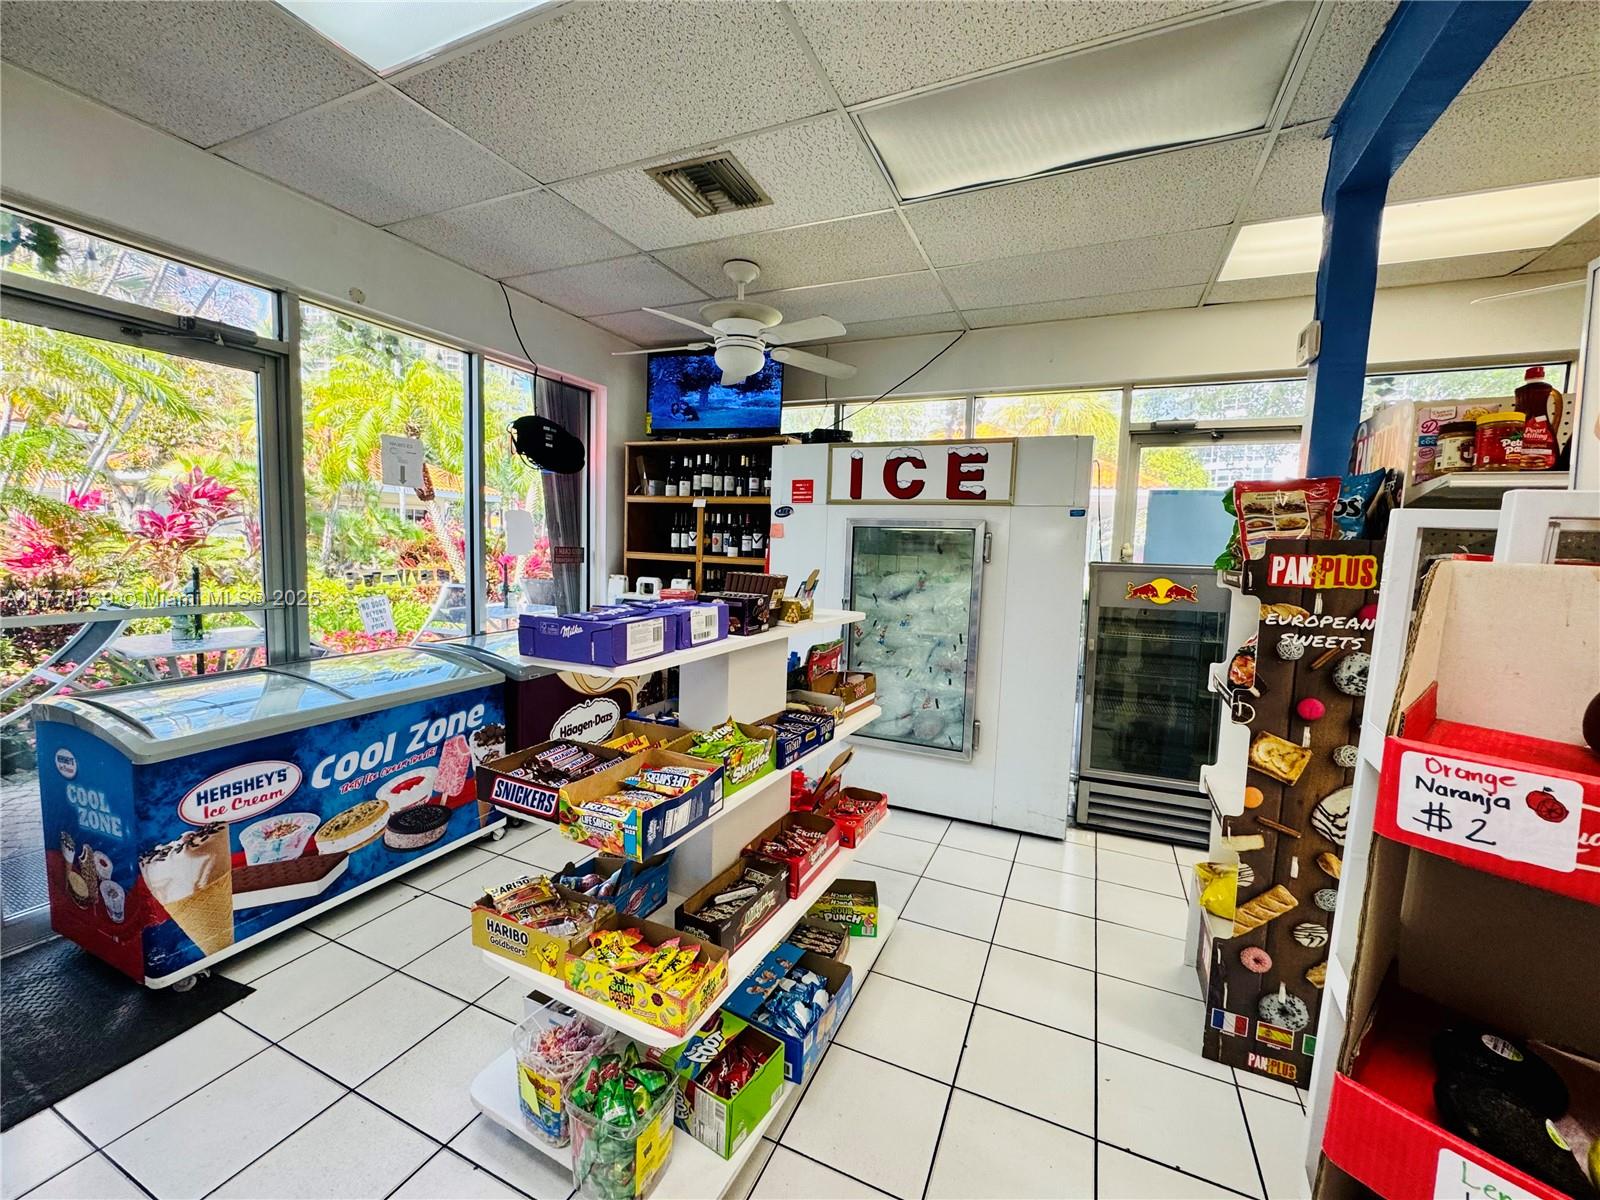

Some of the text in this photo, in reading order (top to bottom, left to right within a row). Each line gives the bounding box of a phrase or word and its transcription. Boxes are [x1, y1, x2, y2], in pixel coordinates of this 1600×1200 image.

[850, 446, 989, 500] ICE
[561, 624, 584, 639] Milka
[1264, 613, 1376, 631] EUROPEAN
[1281, 633, 1366, 651] SWEETS
[559, 712, 613, 738] Häagen-Dazs
[195, 767, 288, 807] HERSHEY'S
[1425, 756, 1517, 795] Orange
[66, 783, 111, 813] COOL
[202, 788, 286, 820] Ice Cream
[494, 779, 557, 813] SNICKERS
[1415, 775, 1512, 815] Naranja
[78, 806, 123, 838] ZONE
[581, 815, 614, 831] LIFE SAVERS
[1412, 801, 1497, 845] $ 2
[824, 912, 863, 924] PUNCH
[831, 907, 855, 915] SOUR
[486, 918, 529, 946] HARIBO
[489, 935, 526, 957] Goldbears
[609, 989, 635, 1006] PATCH
[610, 982, 634, 996] SOUR
